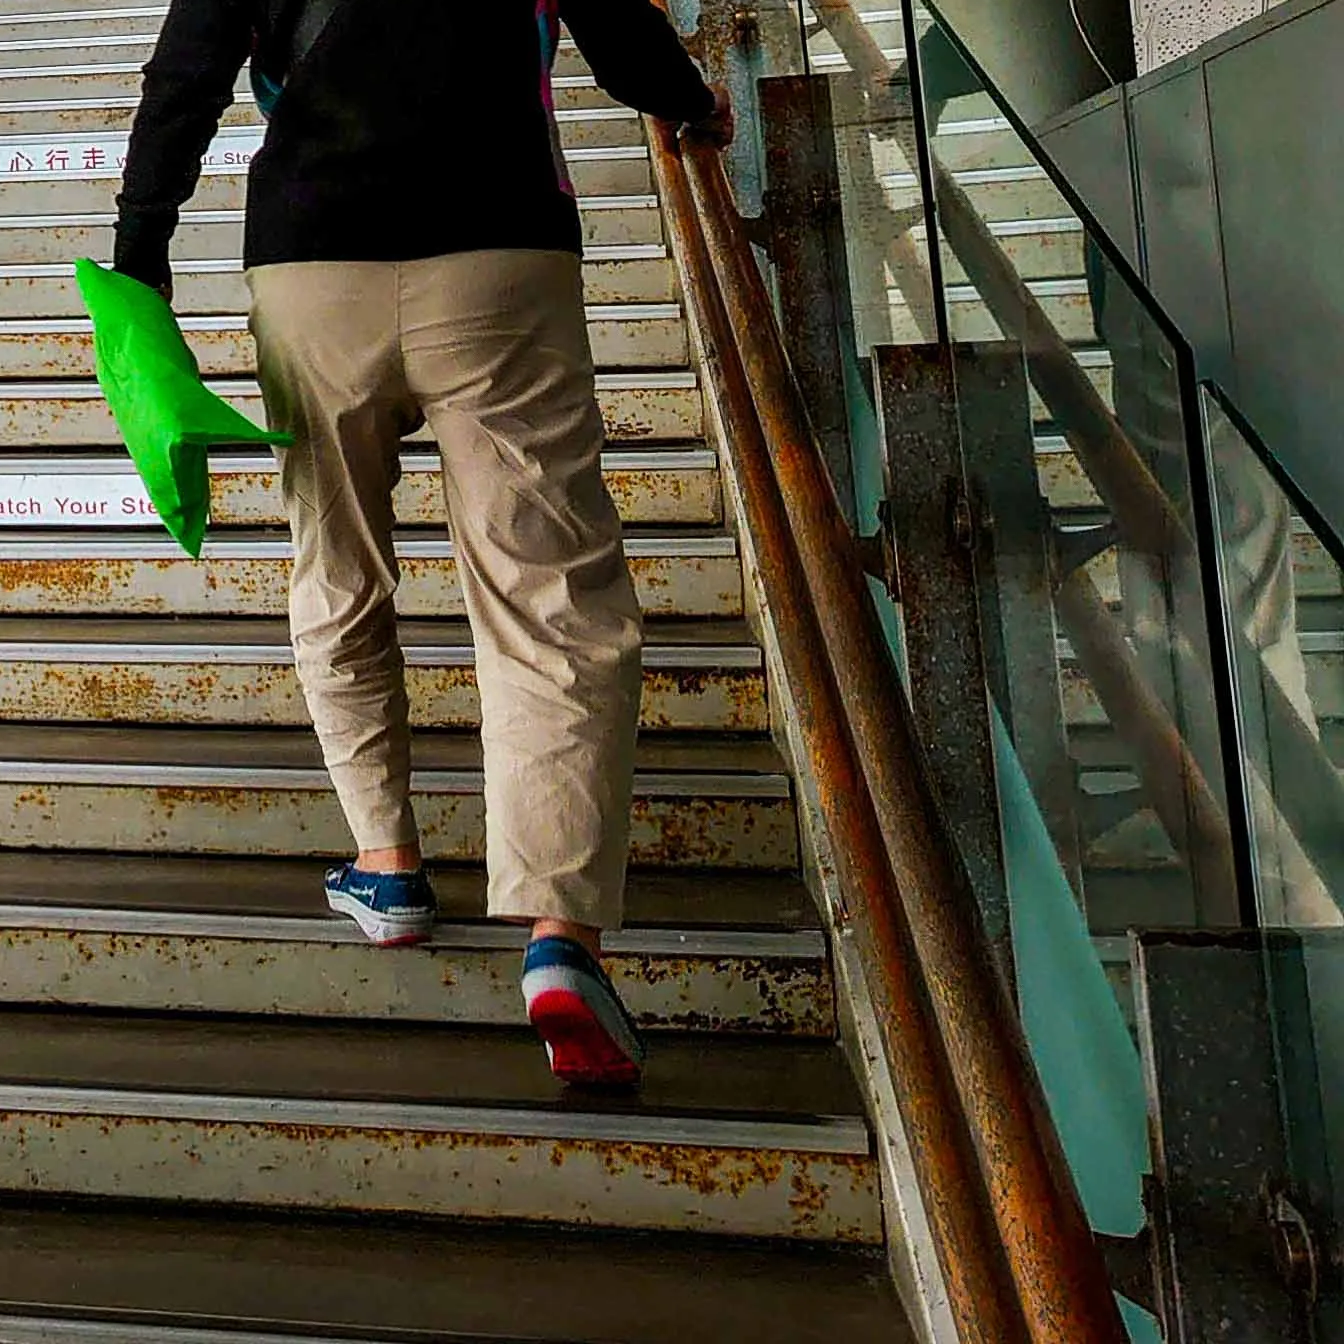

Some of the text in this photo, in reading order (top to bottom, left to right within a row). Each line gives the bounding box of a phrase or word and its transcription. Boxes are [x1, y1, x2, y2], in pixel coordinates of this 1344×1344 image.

[224, 152, 252, 164] Ste
[55, 497, 108, 515] Your
[121, 497, 159, 515] Ste
